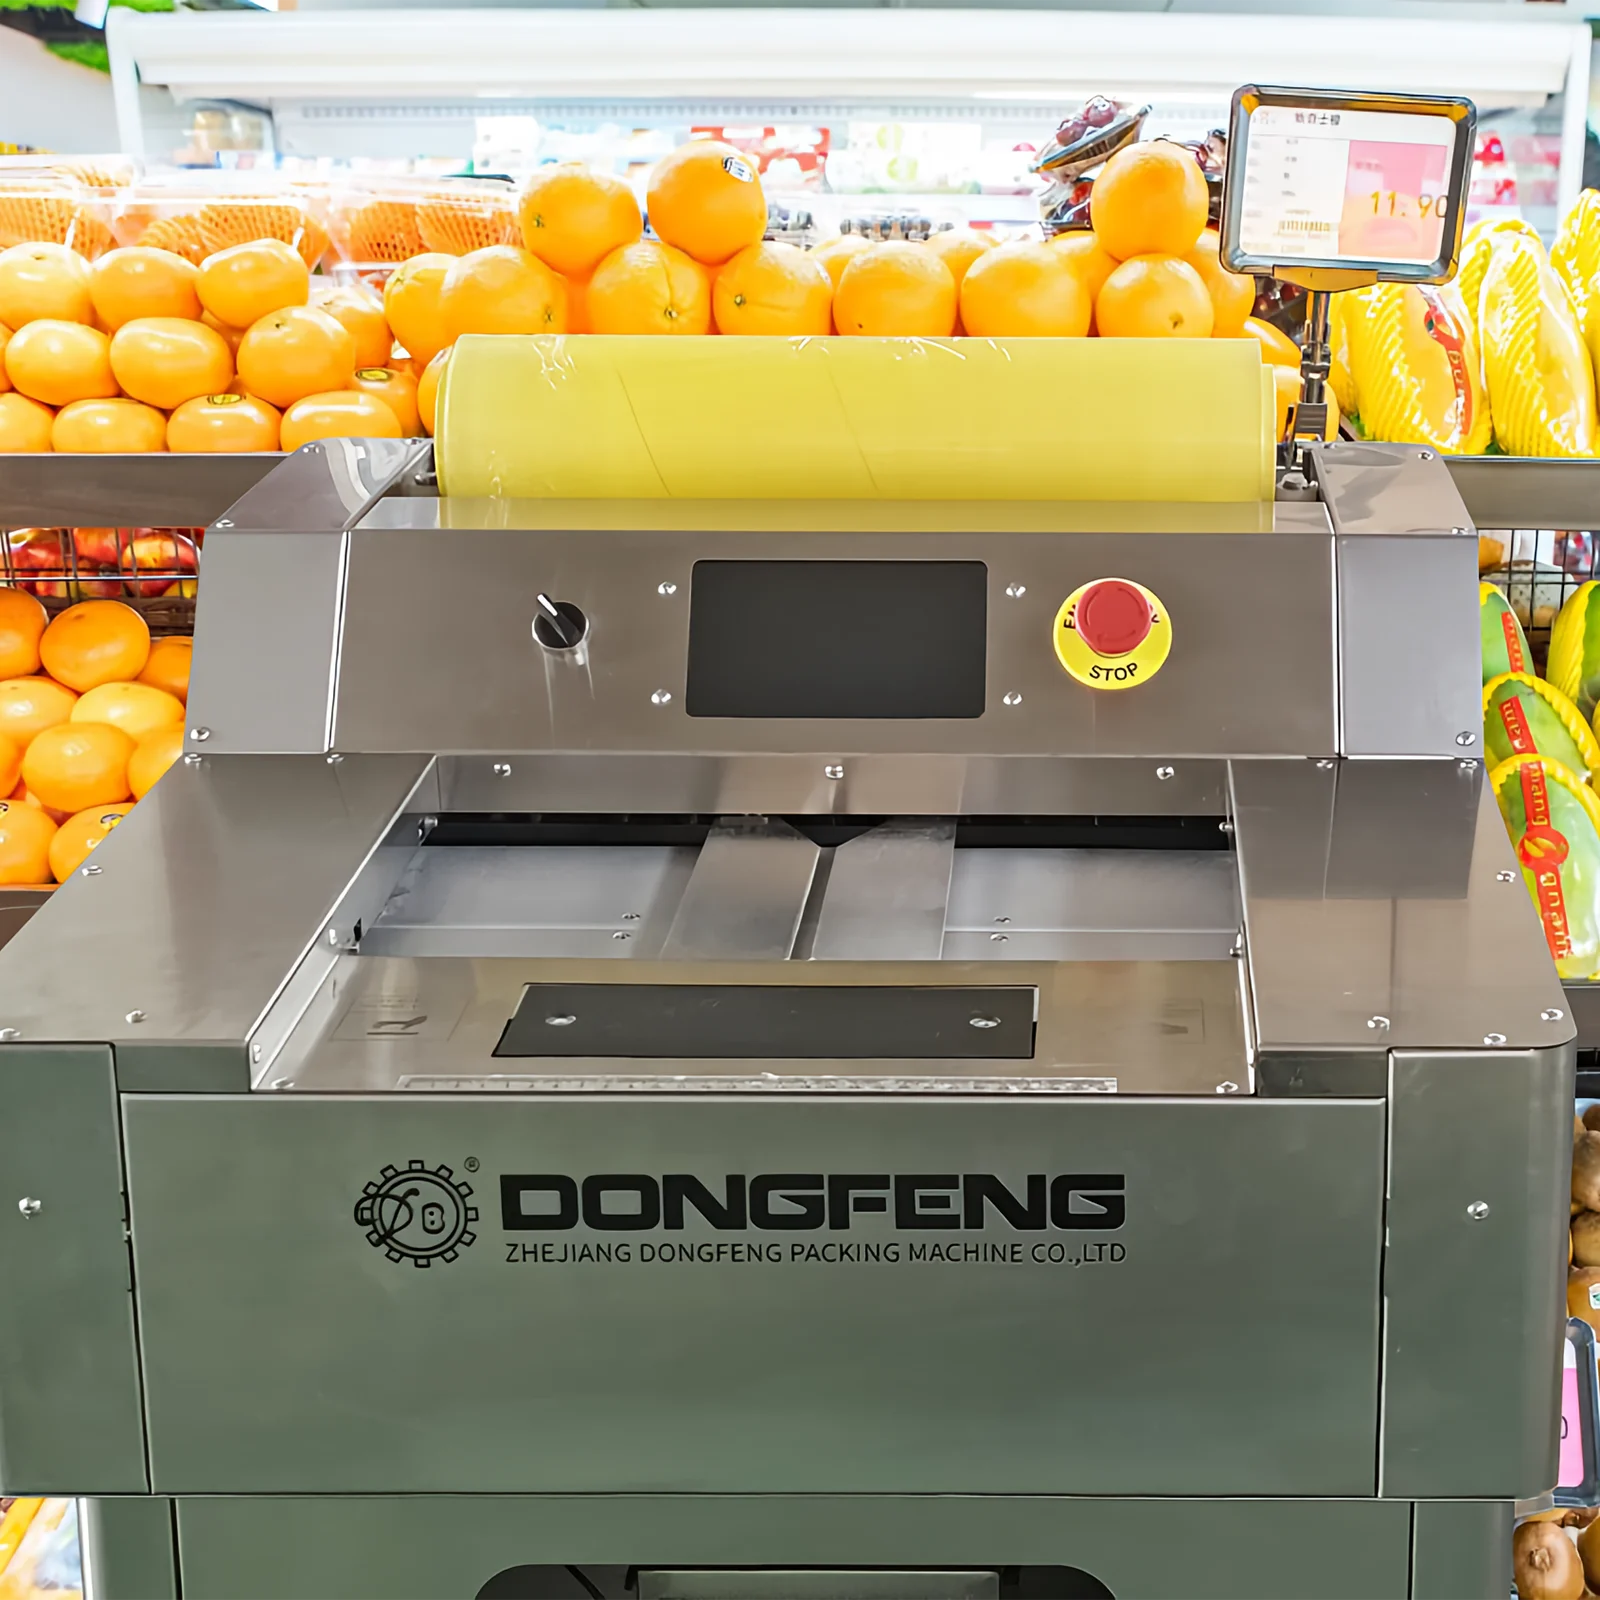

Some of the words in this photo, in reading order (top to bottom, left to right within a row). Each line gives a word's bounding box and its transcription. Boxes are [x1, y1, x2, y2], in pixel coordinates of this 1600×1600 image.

[1370, 190, 1448, 219] 11.90
[1089, 662, 1138, 681] STOP
[500, 1173, 1125, 1231] DONGFENG
[506, 1243, 631, 1263] ZHEJIANG
[641, 1243, 782, 1263] DONGFENG
[791, 1243, 900, 1263] PACKING
[909, 1243, 1023, 1263] MACHINE
[1031, 1243, 1126, 1266] CO.,LTD
